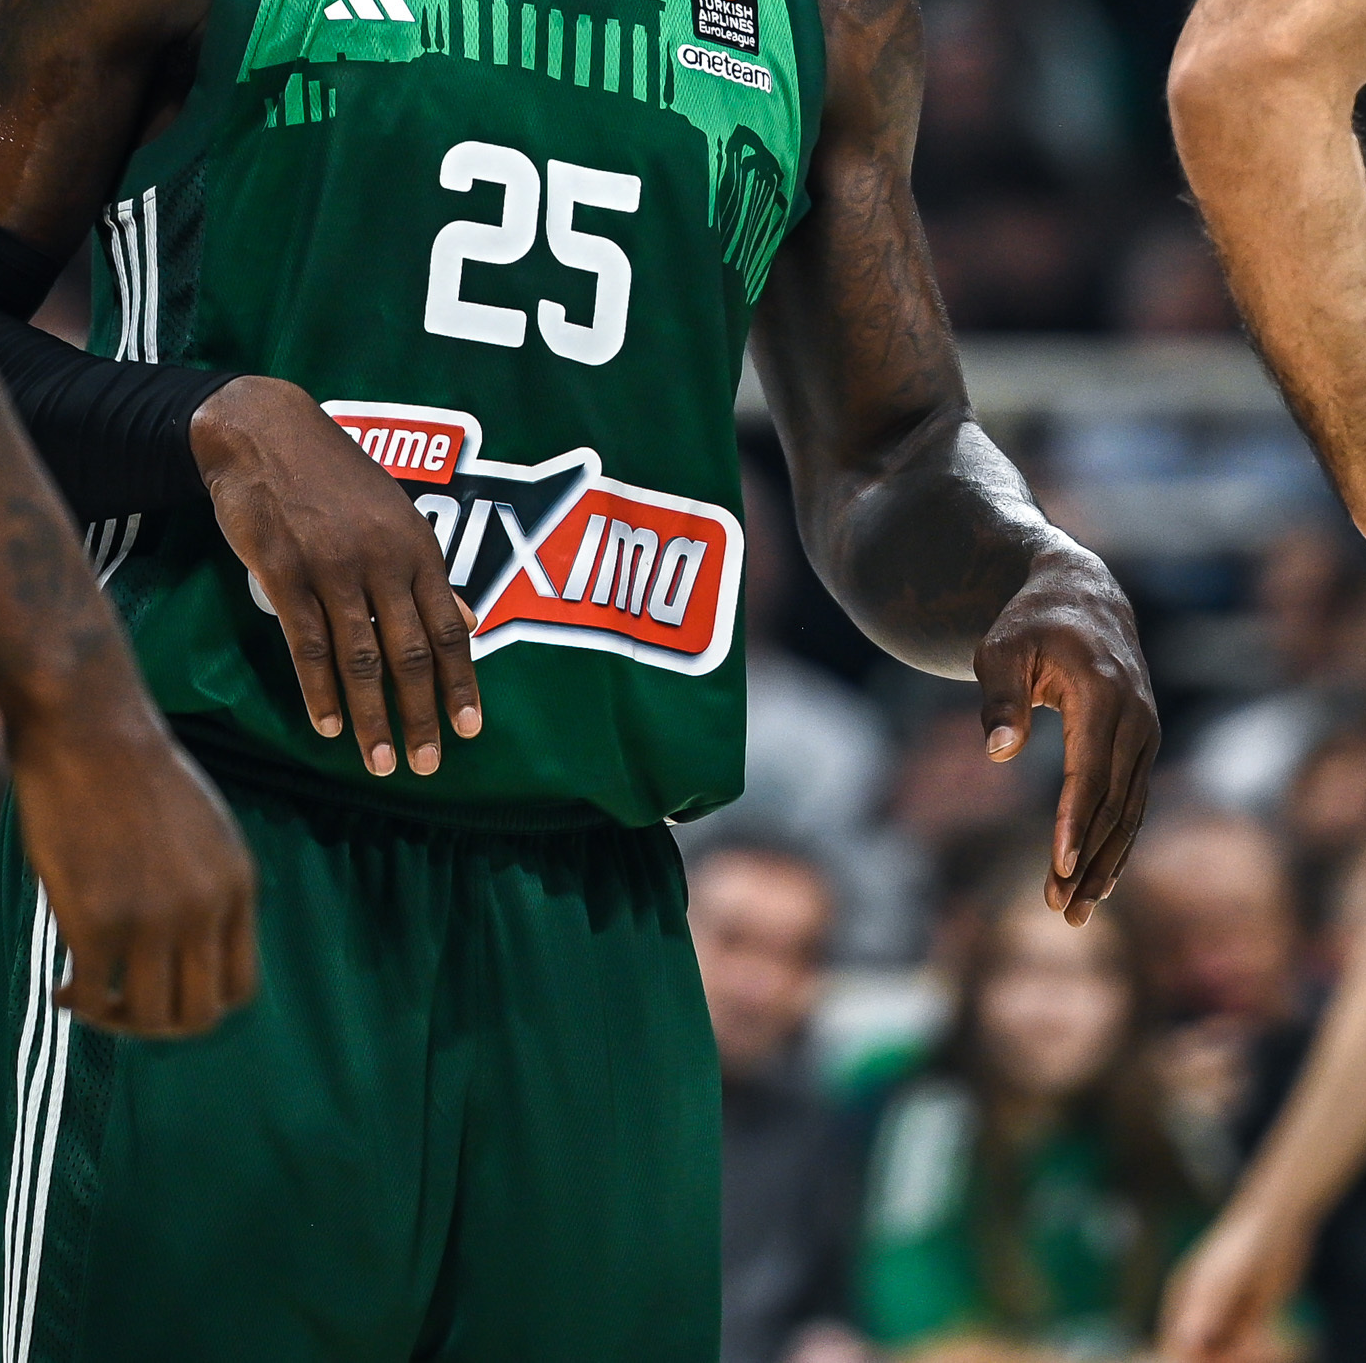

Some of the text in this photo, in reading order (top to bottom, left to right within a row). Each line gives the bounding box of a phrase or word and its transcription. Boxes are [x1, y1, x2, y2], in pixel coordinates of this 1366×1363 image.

[698, 8, 755, 35] AIRLINES
[698, 20, 756, 48] EuroLeague
[682, 48, 771, 91] oneteam
[424, 140, 642, 366] 25
[341, 425, 451, 472] ame
